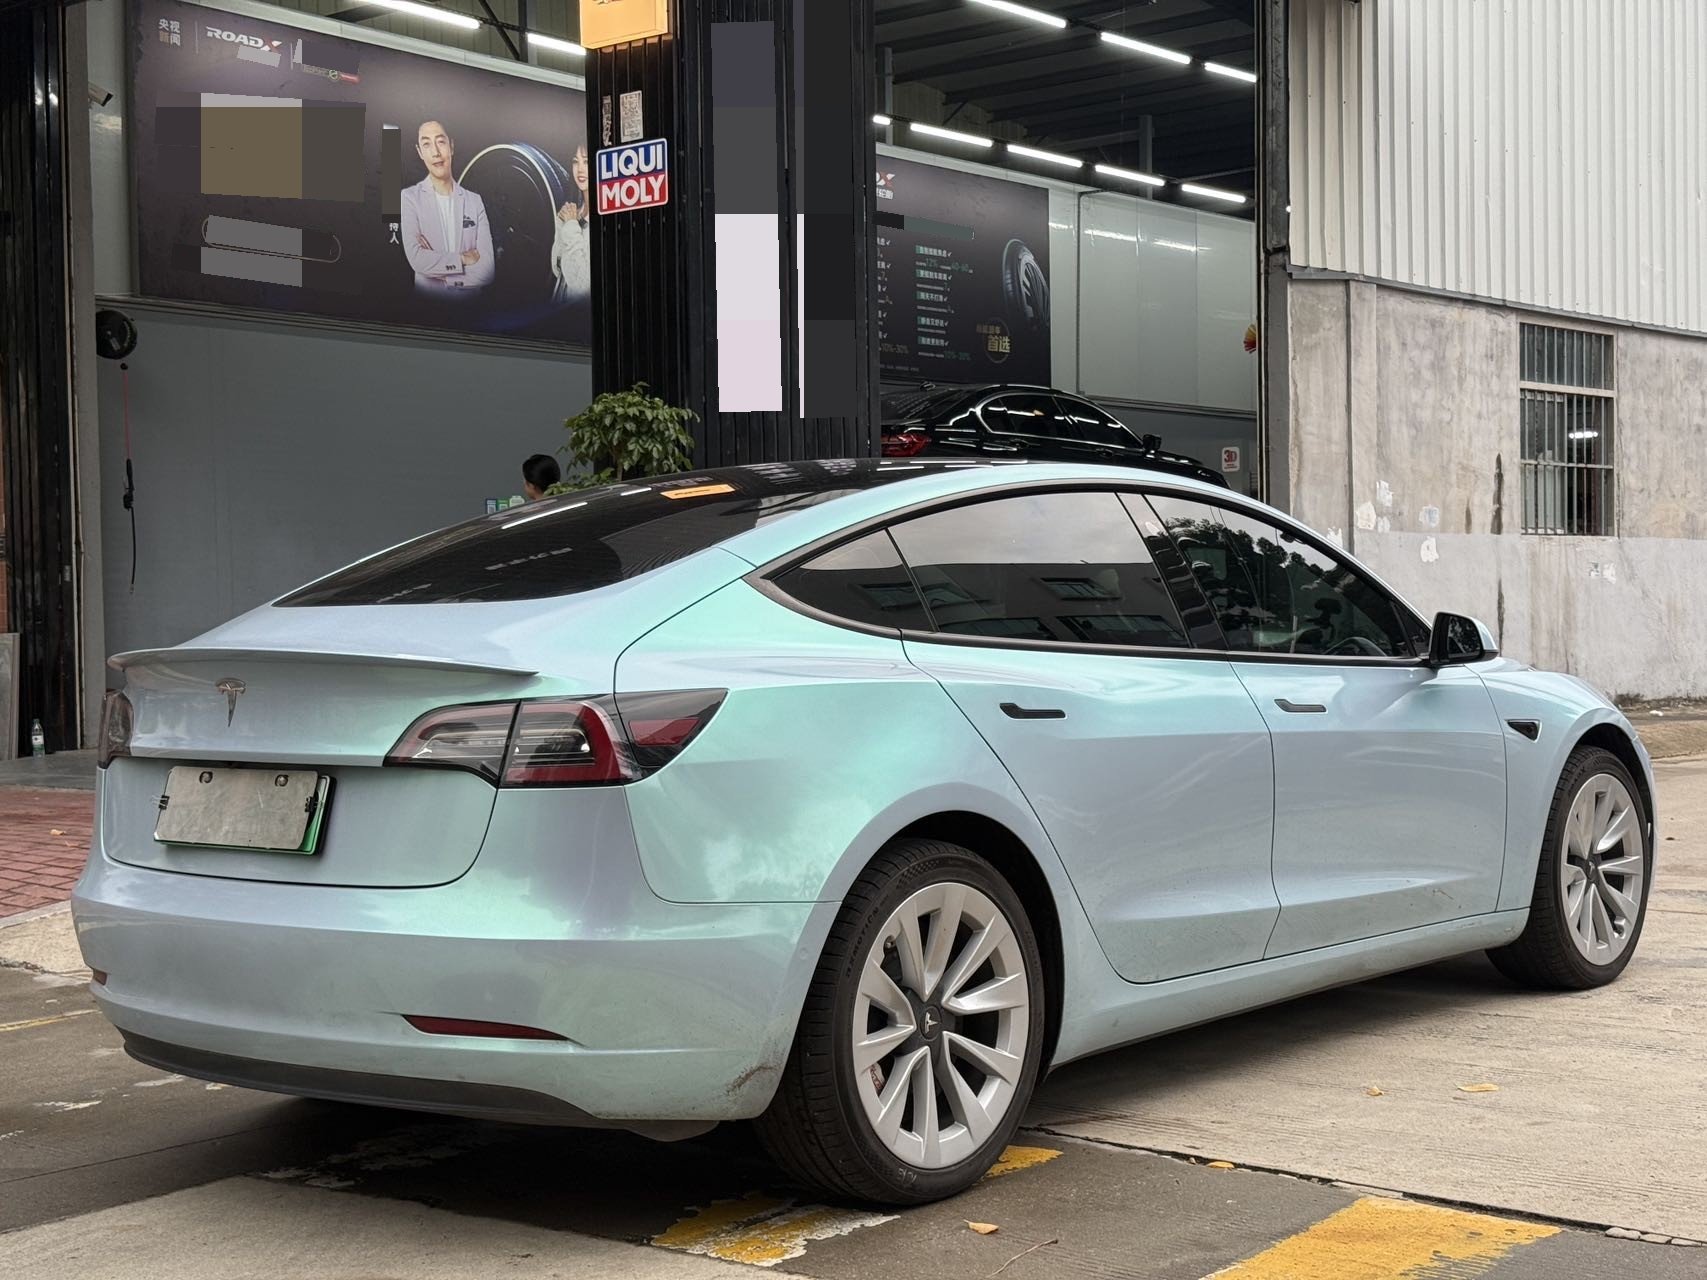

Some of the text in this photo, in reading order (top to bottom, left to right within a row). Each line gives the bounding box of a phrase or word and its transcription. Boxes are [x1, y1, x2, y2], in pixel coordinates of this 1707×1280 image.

[158, 18, 181, 34] 央视
[158, 31, 181, 47] 新闻
[205, 26, 283, 53] ROADX
[602, 144, 662, 179] LIQUI
[601, 174, 666, 210] MOLY
[987, 335, 1011, 353] 首选
[1224, 449, 1238, 463] 3D
